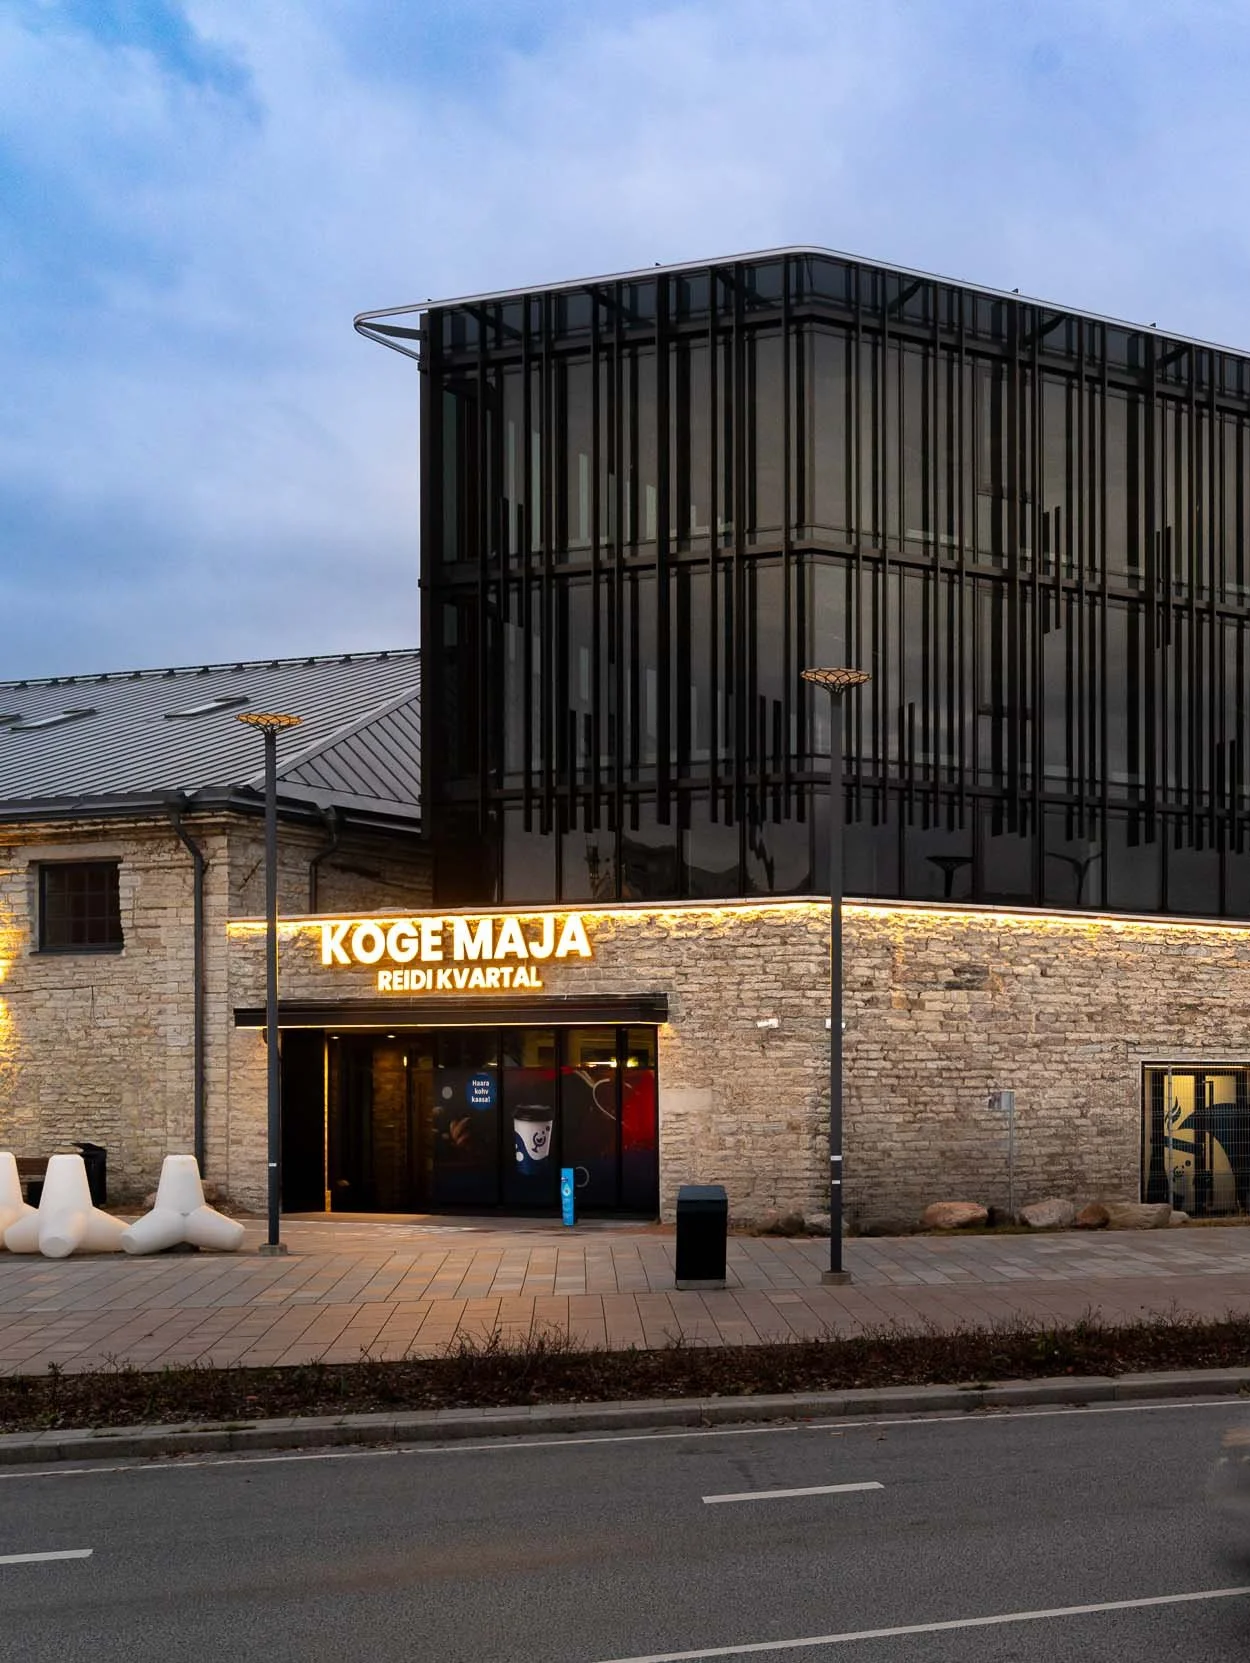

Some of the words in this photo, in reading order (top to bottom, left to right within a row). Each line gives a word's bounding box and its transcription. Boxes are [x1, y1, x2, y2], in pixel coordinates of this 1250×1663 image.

[321, 920, 443, 965] KOGE
[453, 915, 592, 961] MAJA
[377, 968, 433, 991] REIDI
[437, 966, 543, 989] KVARTAL
